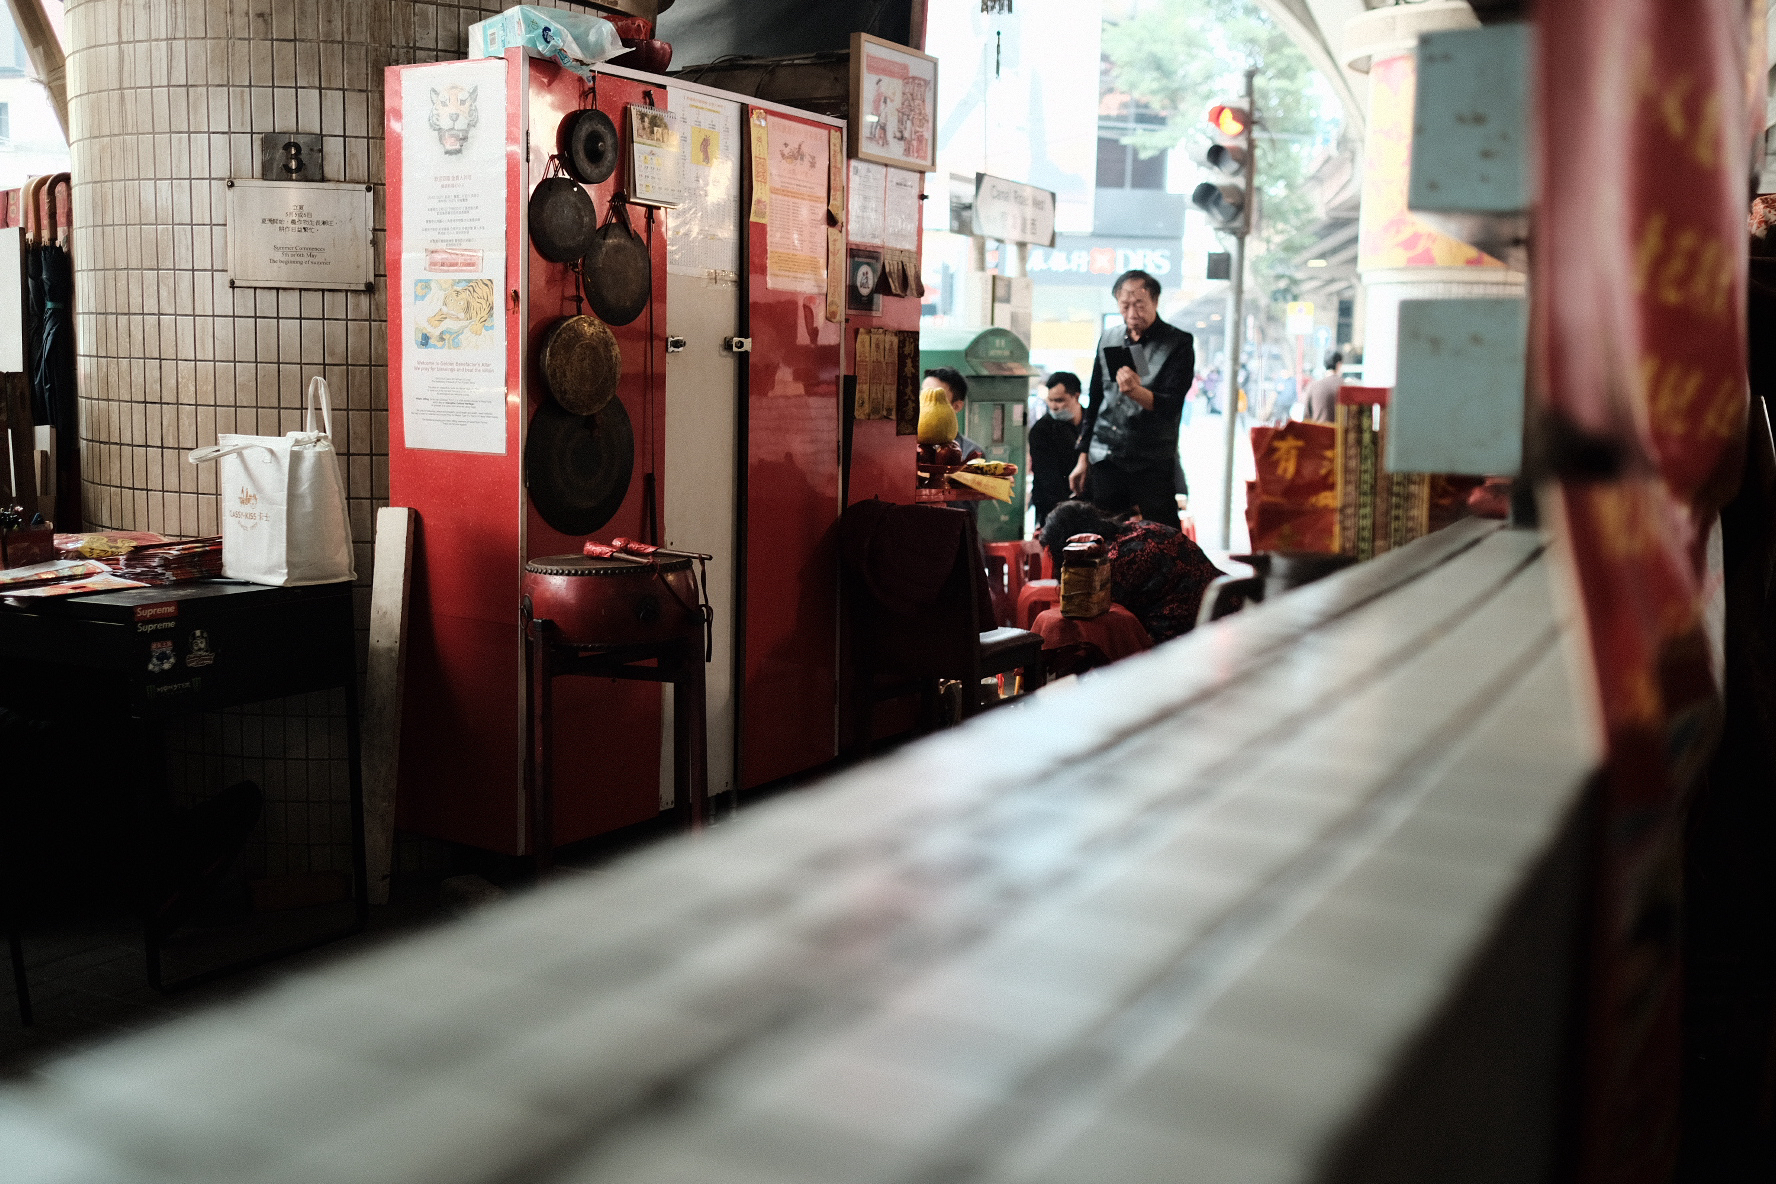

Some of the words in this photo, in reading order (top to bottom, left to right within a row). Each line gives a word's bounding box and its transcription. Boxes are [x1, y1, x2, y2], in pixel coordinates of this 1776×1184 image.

[282, 141, 304, 174] 3
[137, 605, 176, 618] Supreme
[137, 621, 176, 633] Supreme
